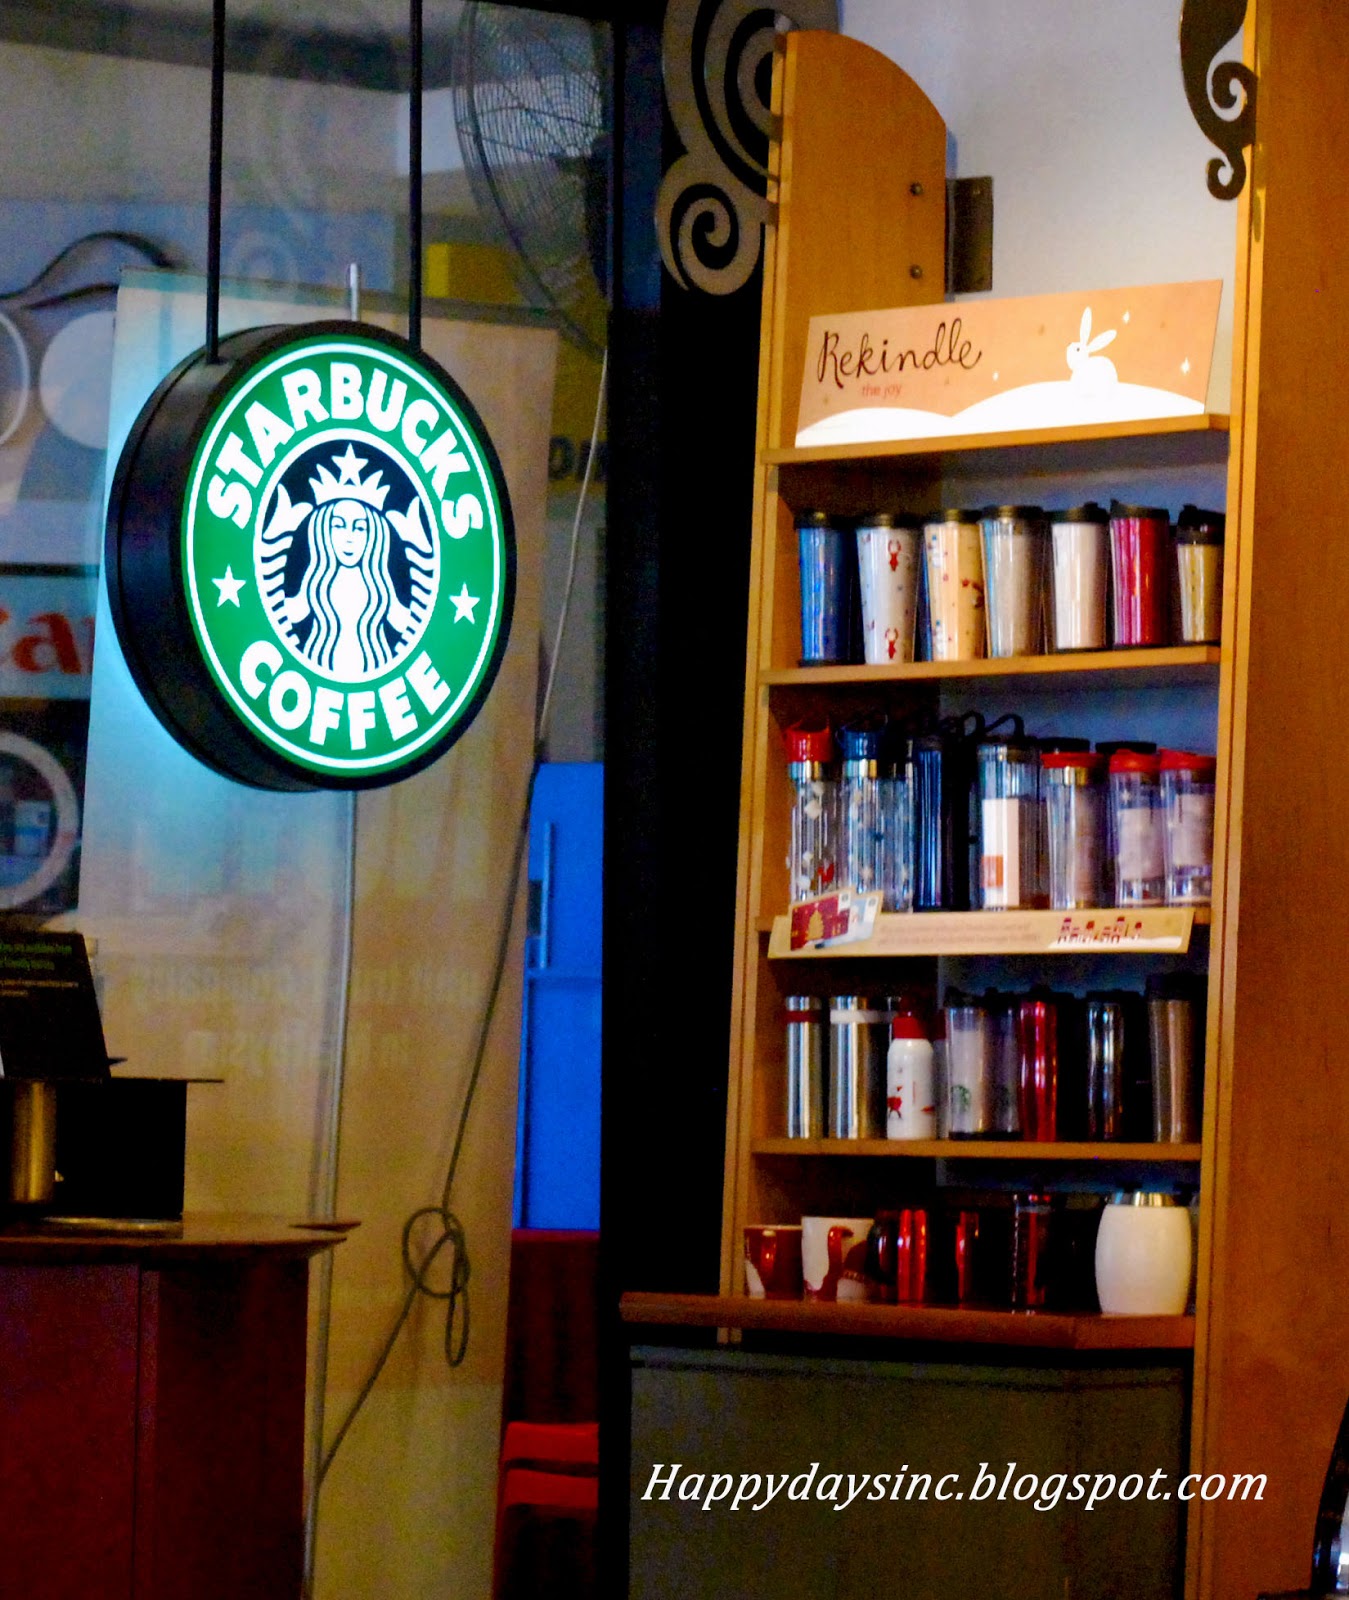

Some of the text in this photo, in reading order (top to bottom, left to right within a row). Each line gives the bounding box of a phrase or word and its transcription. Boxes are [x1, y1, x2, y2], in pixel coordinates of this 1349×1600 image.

[817, 317, 982, 389] Rekindle
[861, 383, 903, 399] the joy
[207, 362, 484, 540] STARBUCKS
[239, 640, 451, 751] COFFEE
